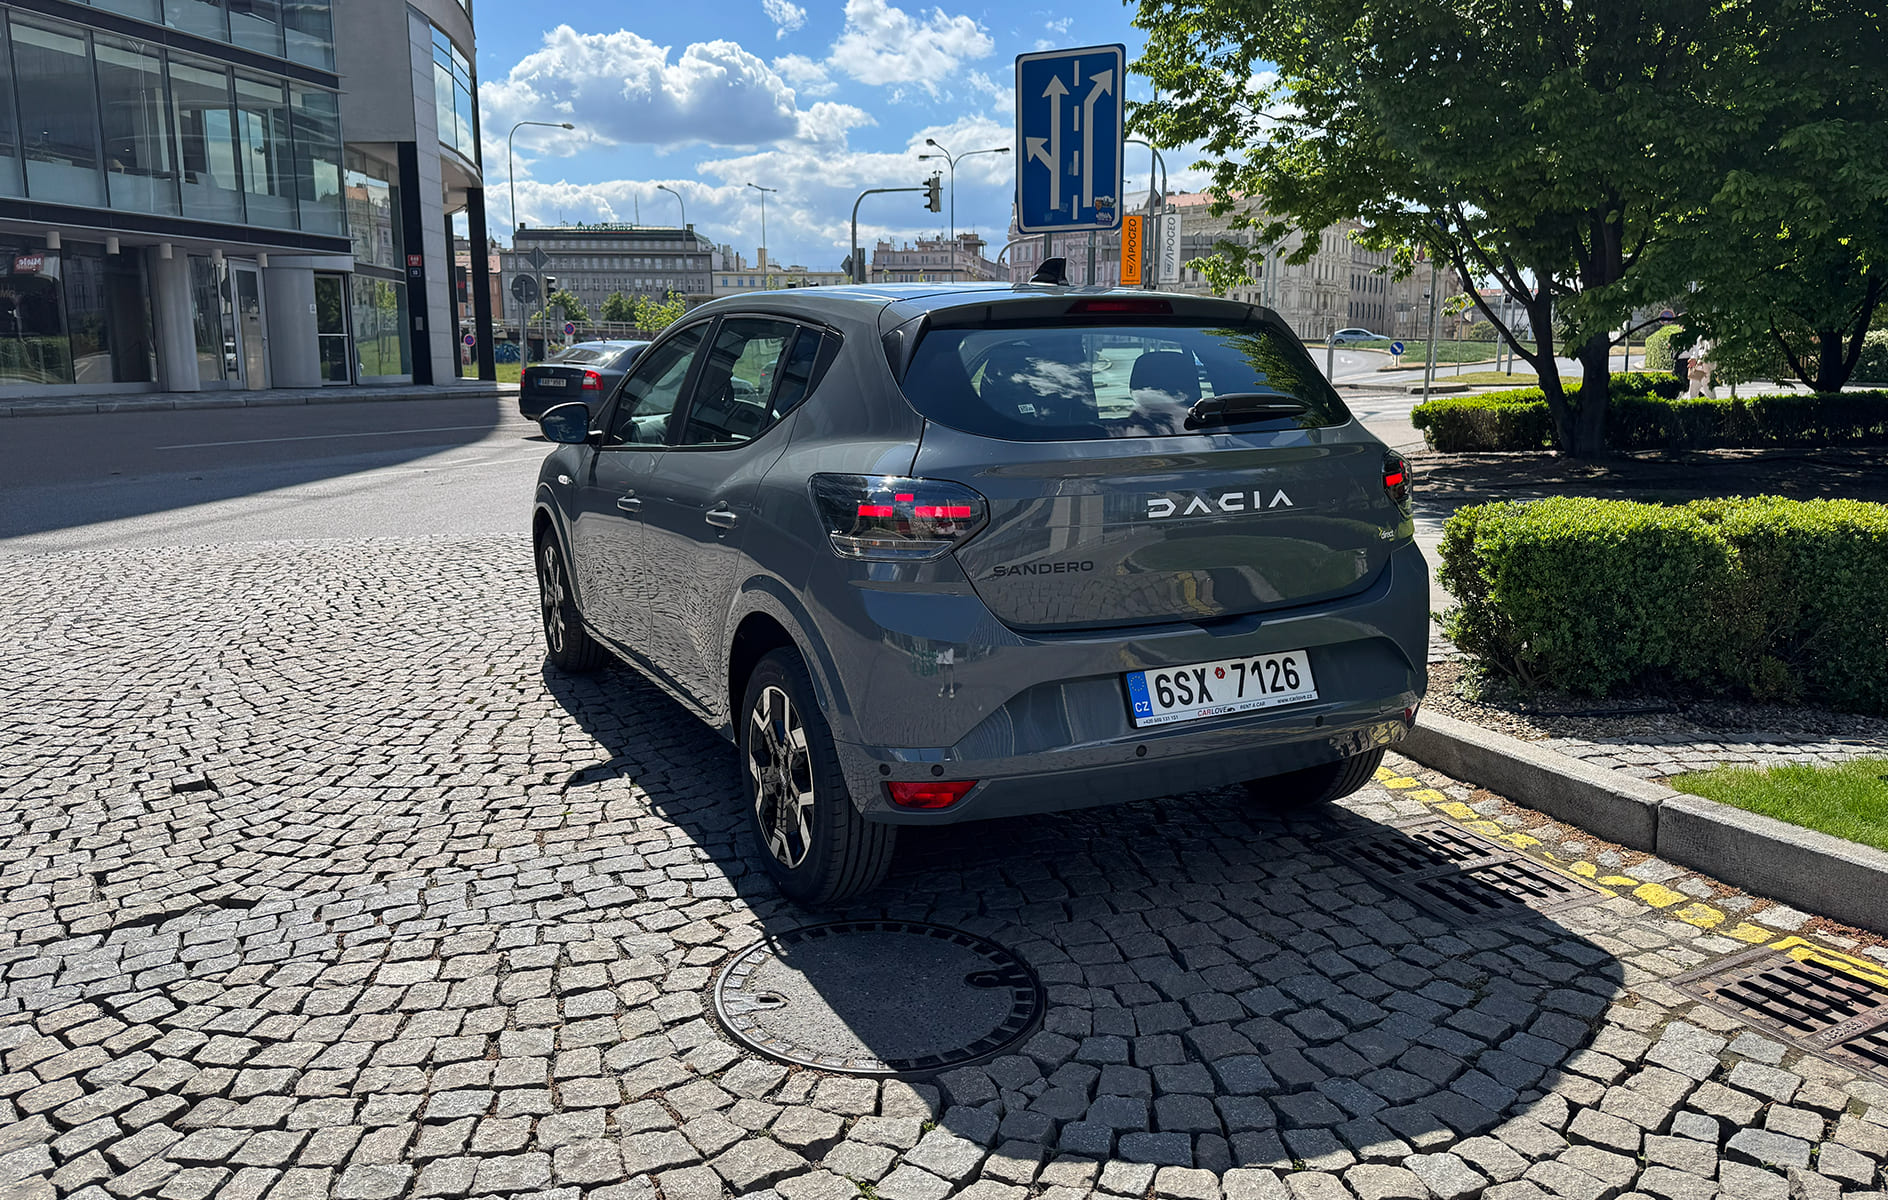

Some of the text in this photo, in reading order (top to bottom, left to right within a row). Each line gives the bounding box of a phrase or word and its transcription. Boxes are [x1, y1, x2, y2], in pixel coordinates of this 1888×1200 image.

[1127, 218, 1137, 262] APOGEO
[1166, 217, 1176, 260] APOGEO
[1147, 489, 1294, 519] DACIA
[992, 560, 1095, 577] SANDERO
[1154, 656, 1301, 709] 6SX 7126
[1134, 701, 1151, 713] CZ
[1197, 706, 1228, 717] CARLOVE
[1240, 702, 1252, 710] RENT
